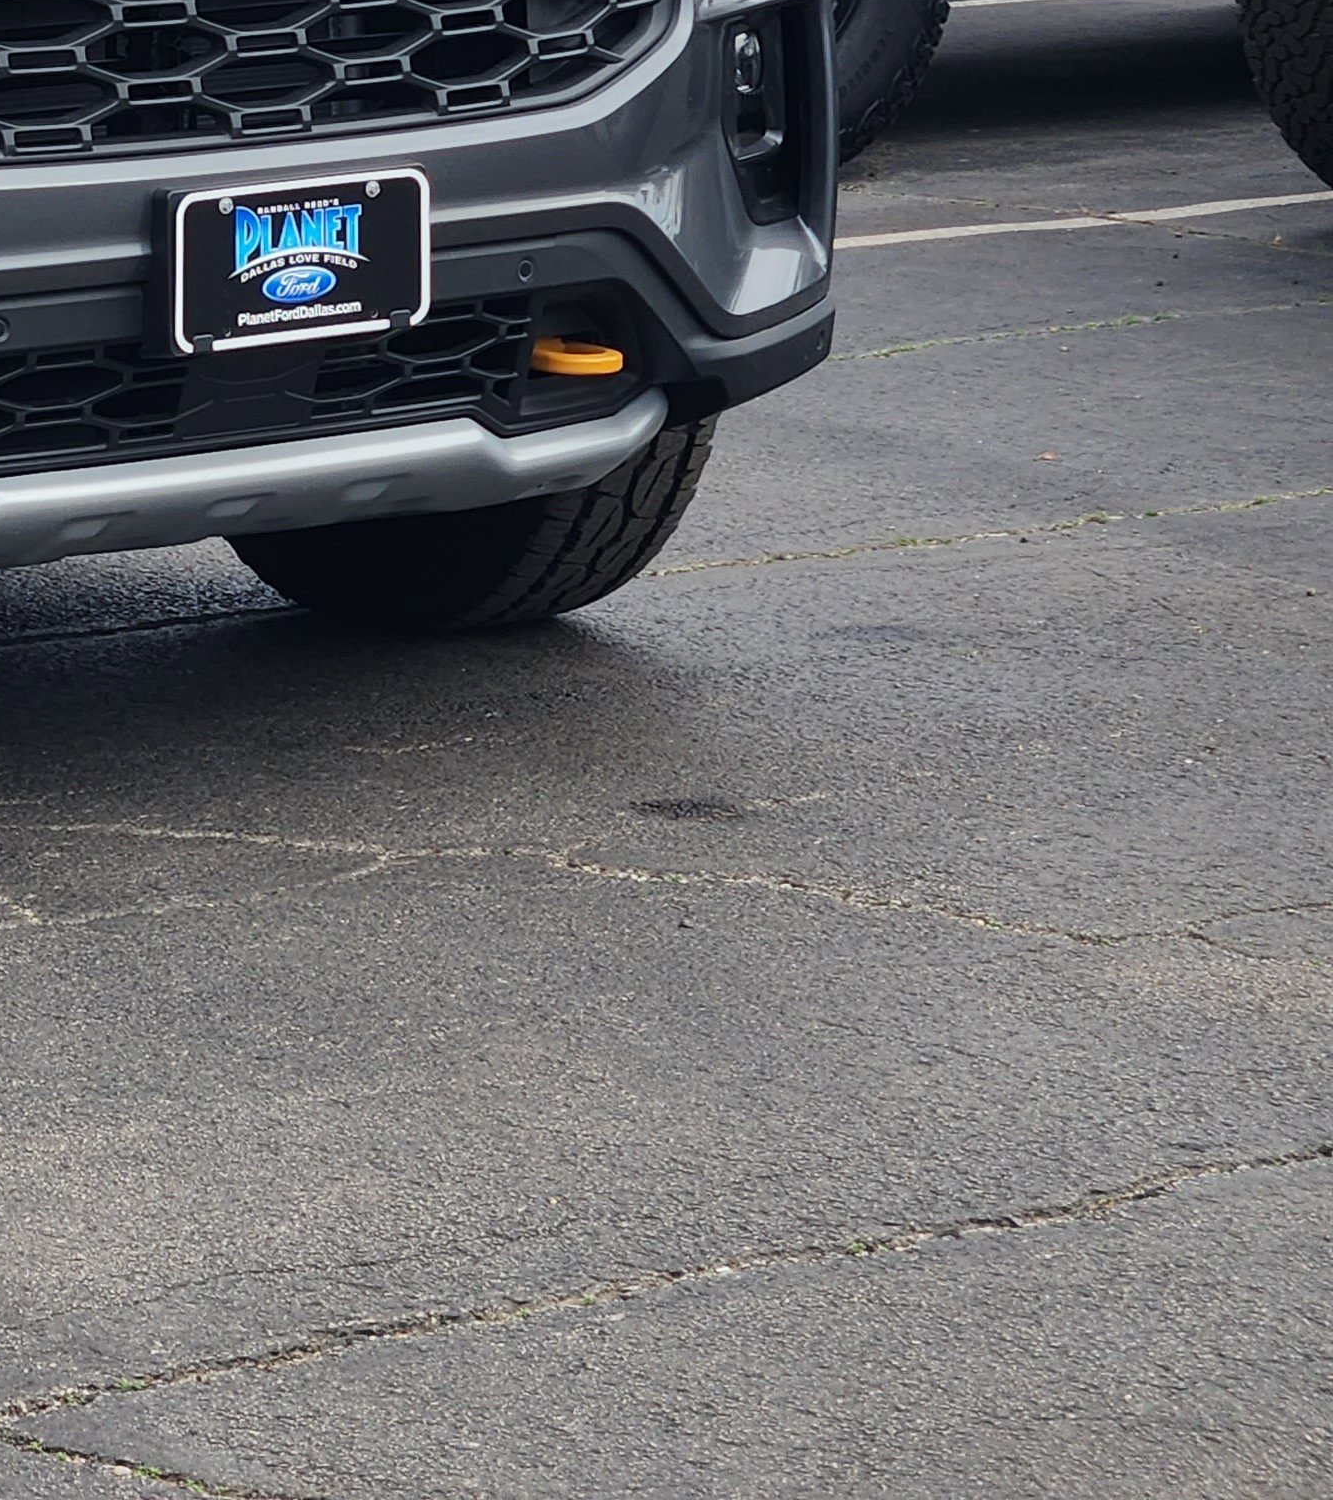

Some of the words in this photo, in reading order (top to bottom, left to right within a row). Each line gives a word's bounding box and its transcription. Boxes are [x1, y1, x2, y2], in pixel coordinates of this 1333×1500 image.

[235, 203, 362, 273] PLANET
[240, 256, 286, 283] DALLAS
[288, 253, 320, 265] LOVE
[323, 254, 358, 269] FIELD
[276, 272, 322, 298] Ford
[237, 301, 363, 327] PlanetFordDallas.com
